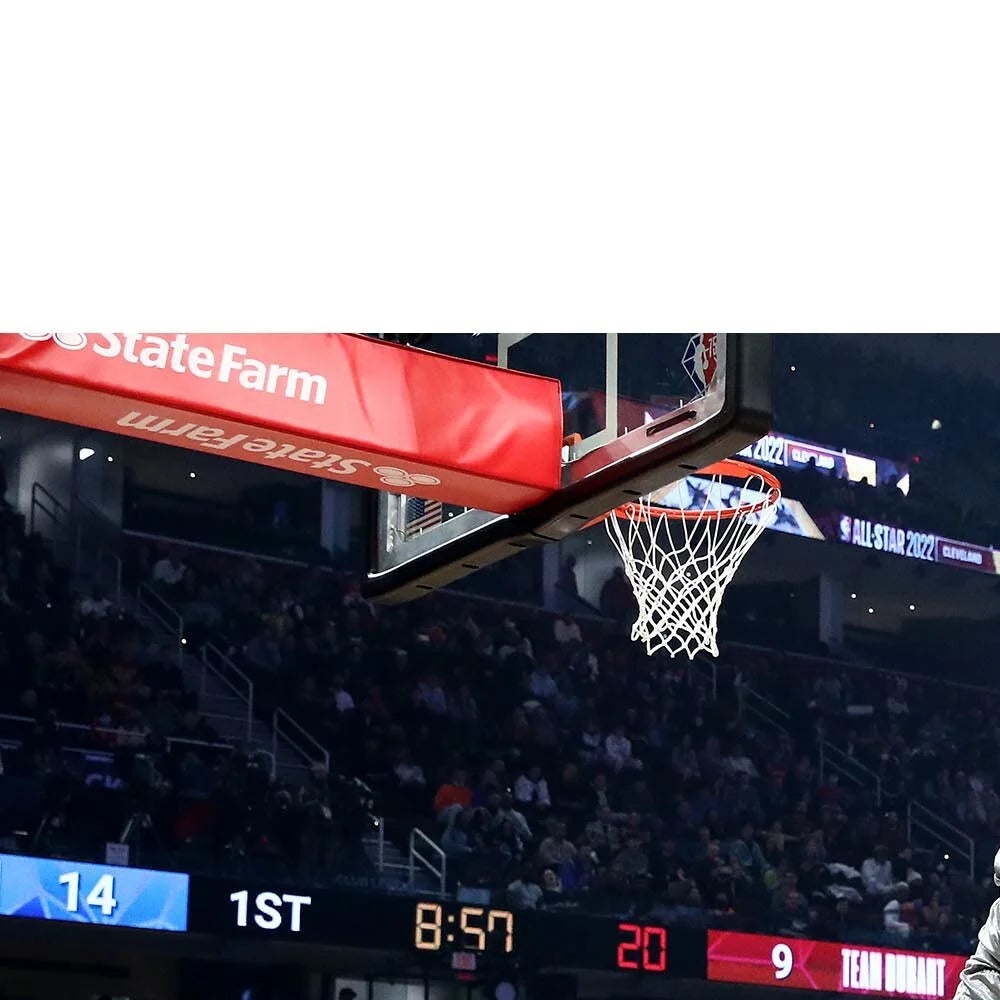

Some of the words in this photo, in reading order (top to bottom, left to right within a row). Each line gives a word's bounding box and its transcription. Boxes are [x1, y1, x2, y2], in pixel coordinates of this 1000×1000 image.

[906, 530, 935, 561] 2022
[58, 871, 118, 916] 14
[230, 890, 312, 932] 1ST
[415, 902, 514, 952] 8:57
[617, 923, 667, 972] 20
[771, 943, 793, 980] 9
[841, 948, 882, 991] TEAM
